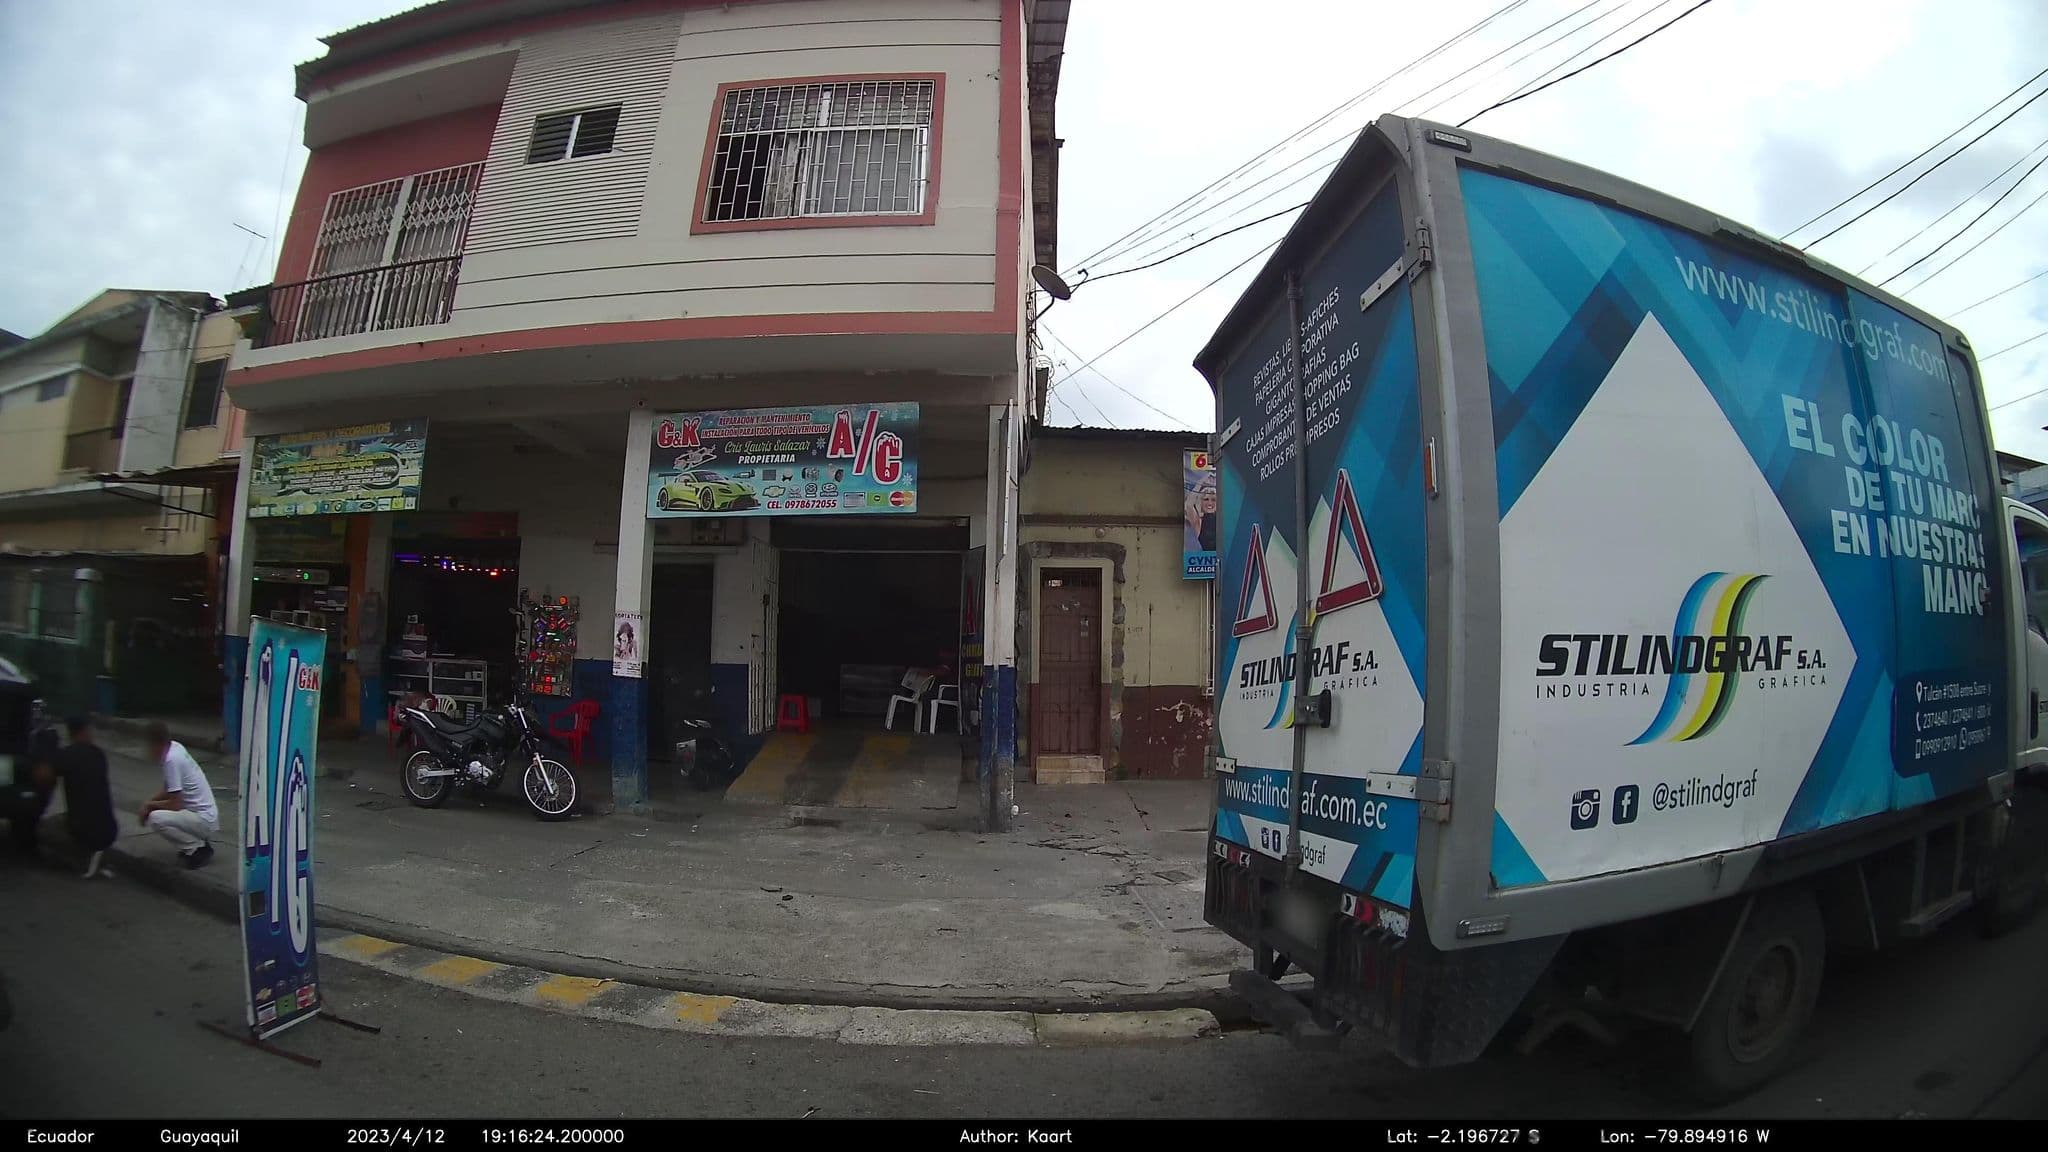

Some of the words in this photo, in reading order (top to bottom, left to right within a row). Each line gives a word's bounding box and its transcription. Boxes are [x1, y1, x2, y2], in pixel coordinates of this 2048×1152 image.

[1283, 286, 1339, 357] LIBS-AFICHES
[1675, 256, 1952, 385] www.stilindgraf.com
[1246, 425, 1264, 453] CAJAS
[1339, 341, 1360, 373] BAG
[1252, 421, 1297, 467] COMPROBANT
[1305, 403, 1318, 422] DE
[1318, 373, 1351, 412] VENTAS
[738, 427, 755, 436] PARA
[756, 426, 772, 436] TODO
[773, 425, 787, 435] TIPO
[788, 425, 797, 434] DE
[773, 439, 811, 452] Salazar
[827, 409, 903, 485] A/C
[1782, 394, 1836, 457] EL
[1841, 412, 1949, 482] COLOR
[738, 454, 796, 464] PROPIETARIA
[1260, 453, 1284, 481] ROLLOS
[784, 499, 837, 509] 0978672055
[1845, 466, 1885, 511] DE
[1891, 471, 1924, 515] TU
[1928, 481, 1981, 530] MARC
[1831, 509, 1871, 556] EN
[1240, 641, 1350, 688] STILINDRAF
[1352, 651, 1378, 673] S.A.
[1536, 633, 1793, 676] STILINDGRAF
[1797, 649, 1827, 670] S.A.
[1240, 689, 1275, 701] INDUSTRIA
[1536, 682, 1650, 698] INDUSTRIA
[1225, 774, 1388, 830] www.stilindaf.com.ec
[1652, 769, 1758, 811] @stilindgraf
